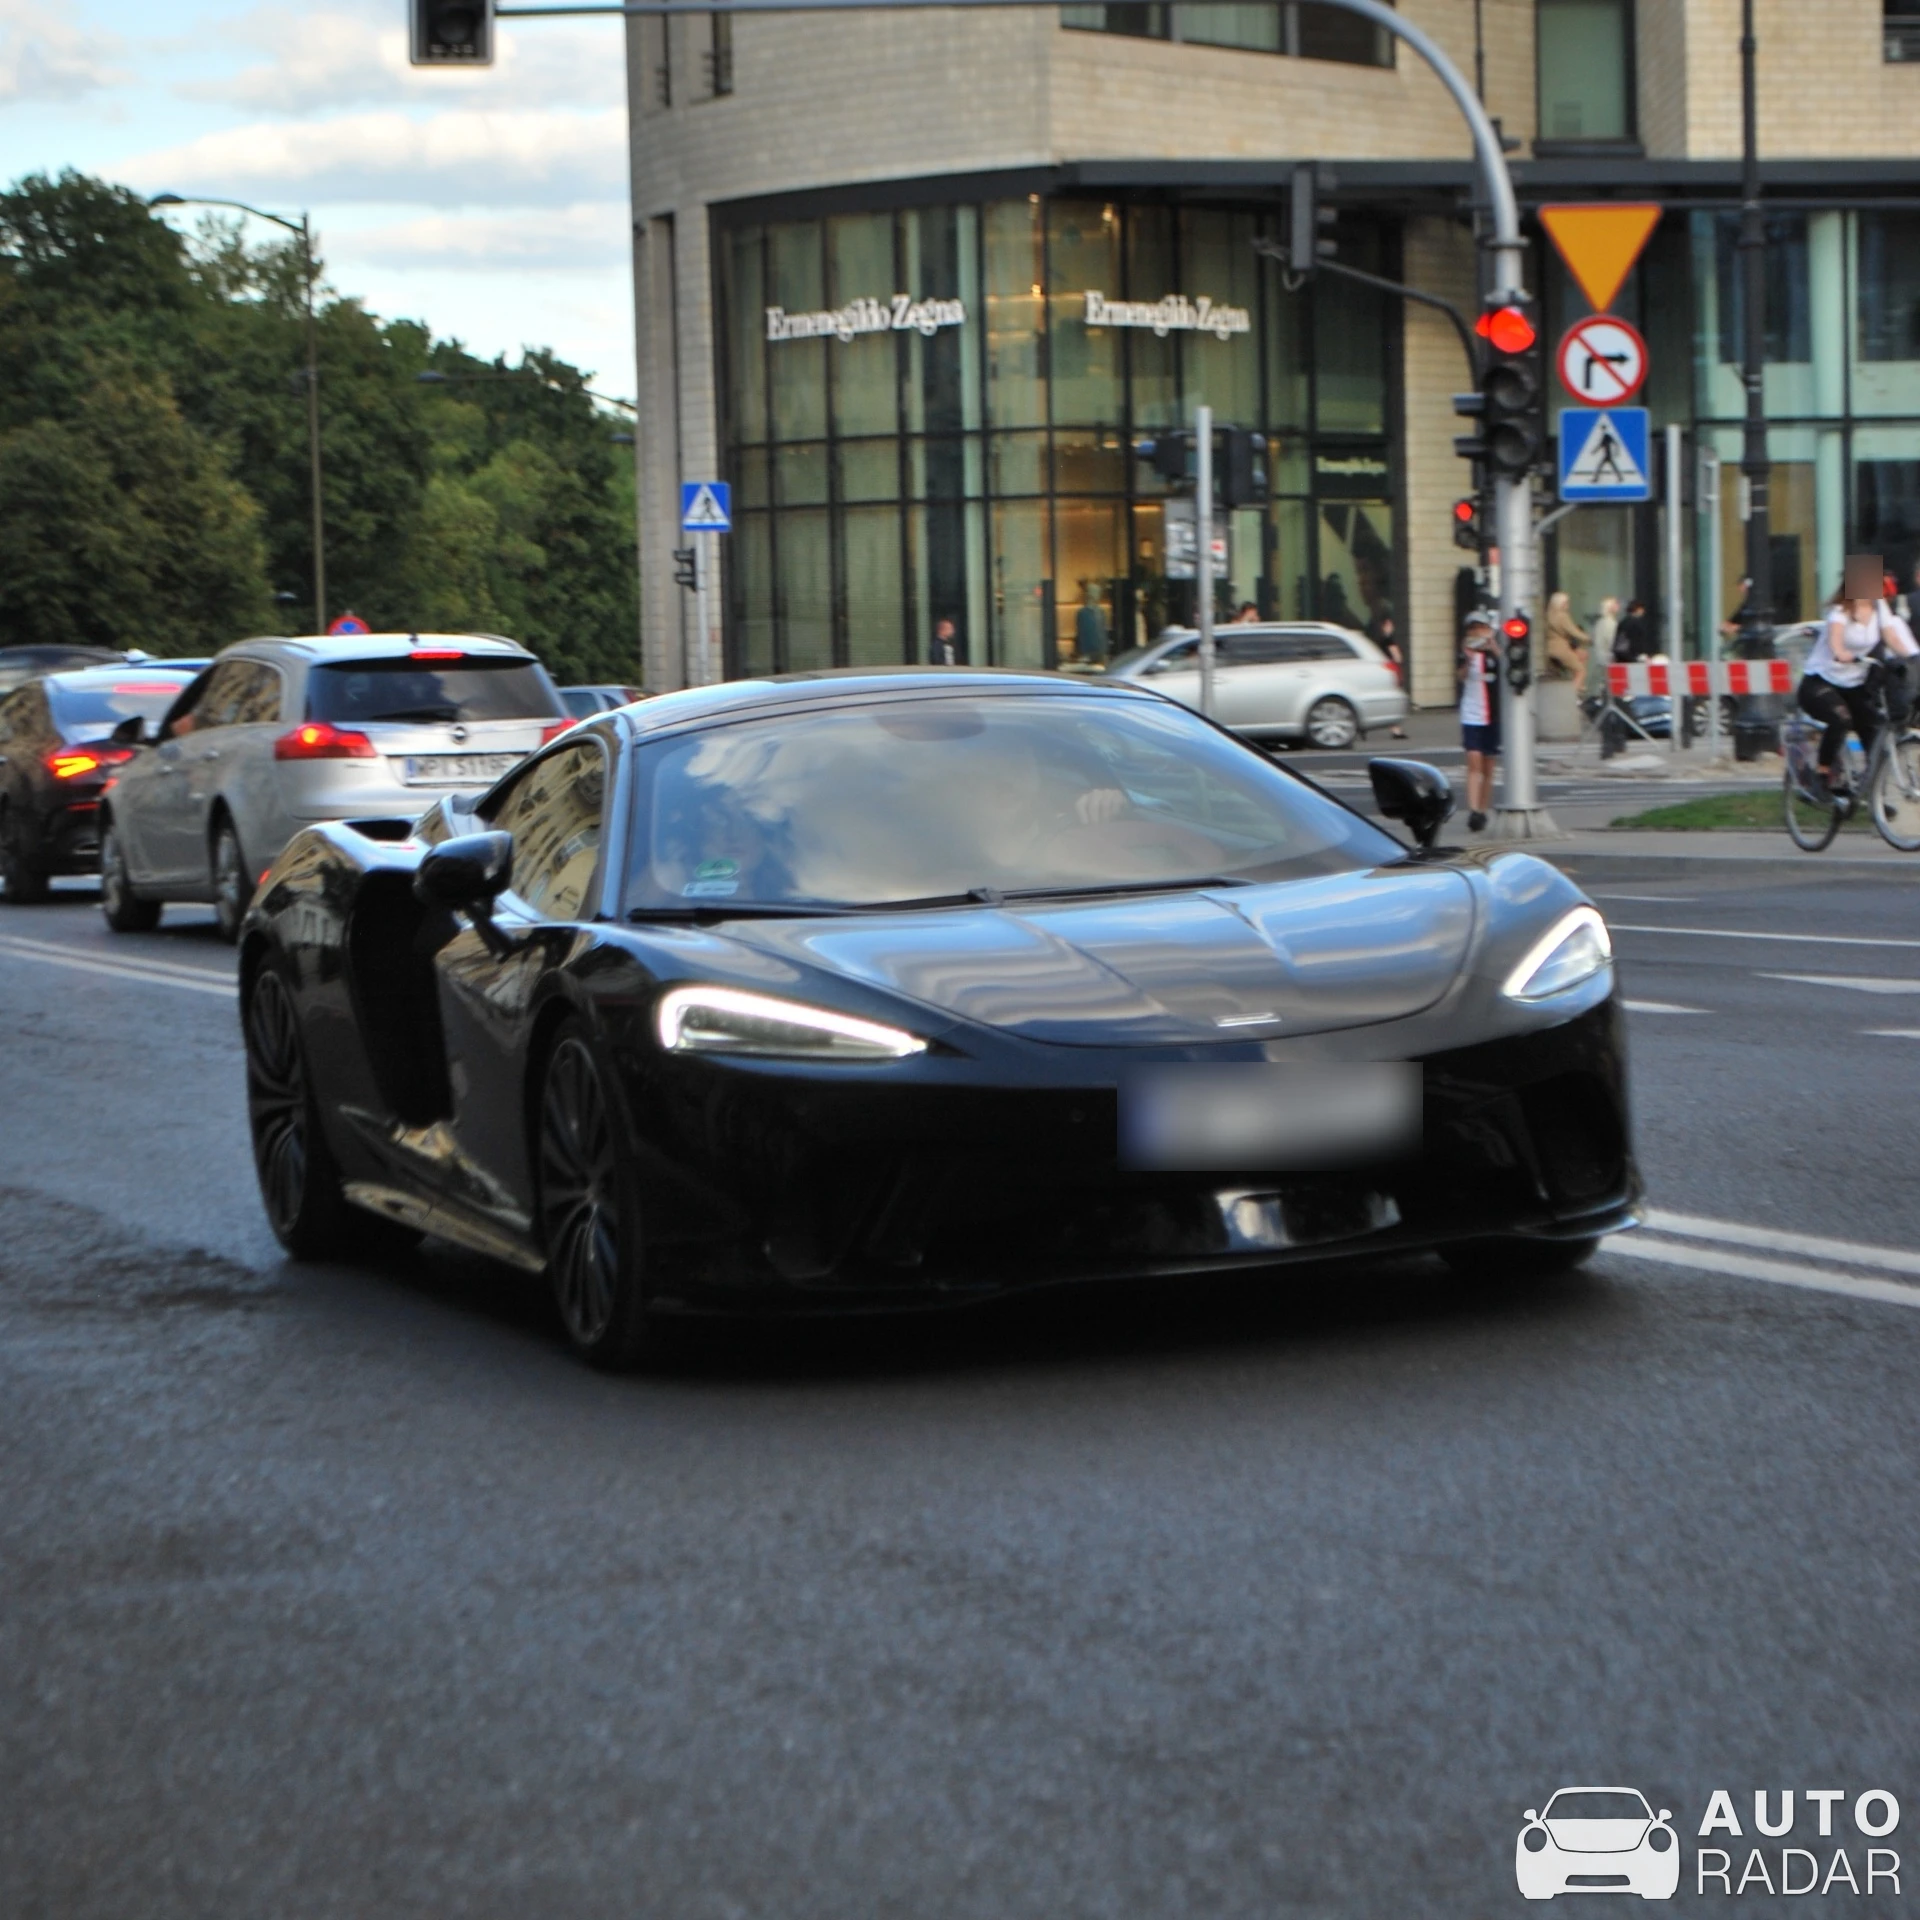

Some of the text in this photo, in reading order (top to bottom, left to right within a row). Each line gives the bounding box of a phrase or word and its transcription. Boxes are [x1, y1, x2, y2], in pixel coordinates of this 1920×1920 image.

[766, 293, 966, 343] Ermenegildo Zegna
[1196, 296, 1251, 341] Zegna
